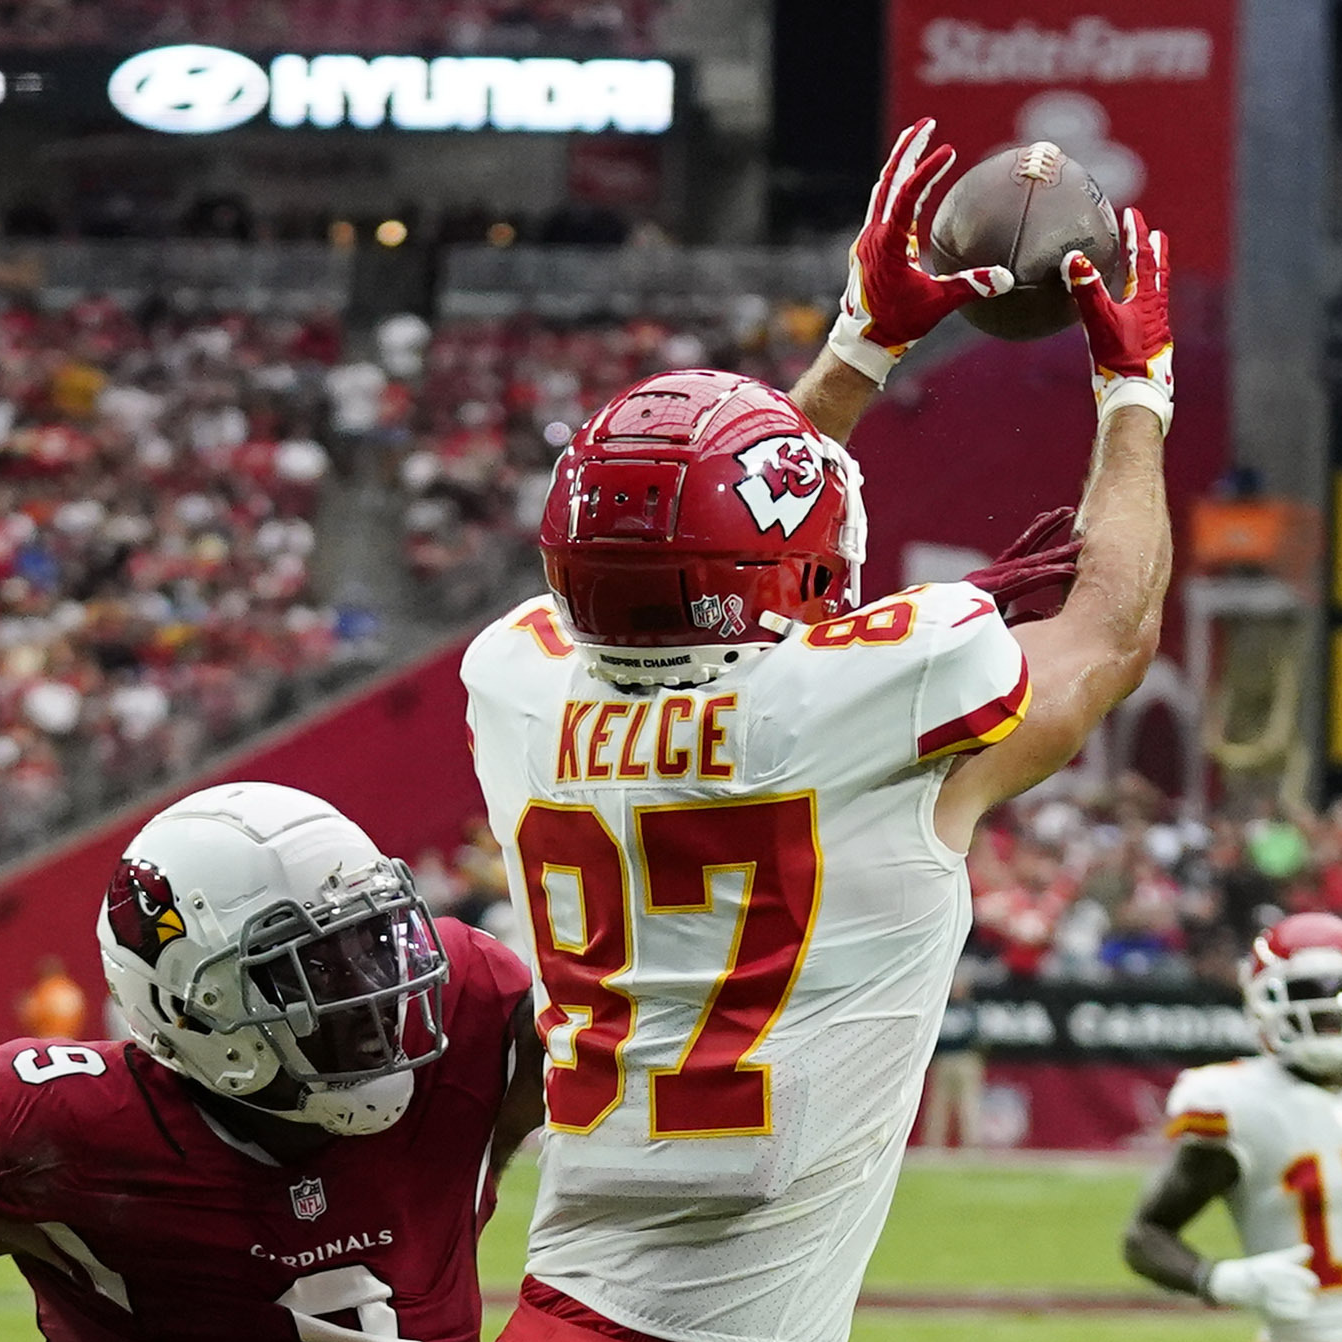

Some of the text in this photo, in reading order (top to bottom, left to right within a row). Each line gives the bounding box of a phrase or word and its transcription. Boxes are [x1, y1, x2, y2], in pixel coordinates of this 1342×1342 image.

[270, 53, 674, 134] HYUNDAI
[643, 654, 692, 668] CHANGE
[554, 692, 739, 785] KELCE
[514, 788, 824, 1140] 87
[12, 1044, 109, 1085] 9
[297, 1193, 323, 1214] NFL
[250, 1229, 394, 1268] CRDINALS
